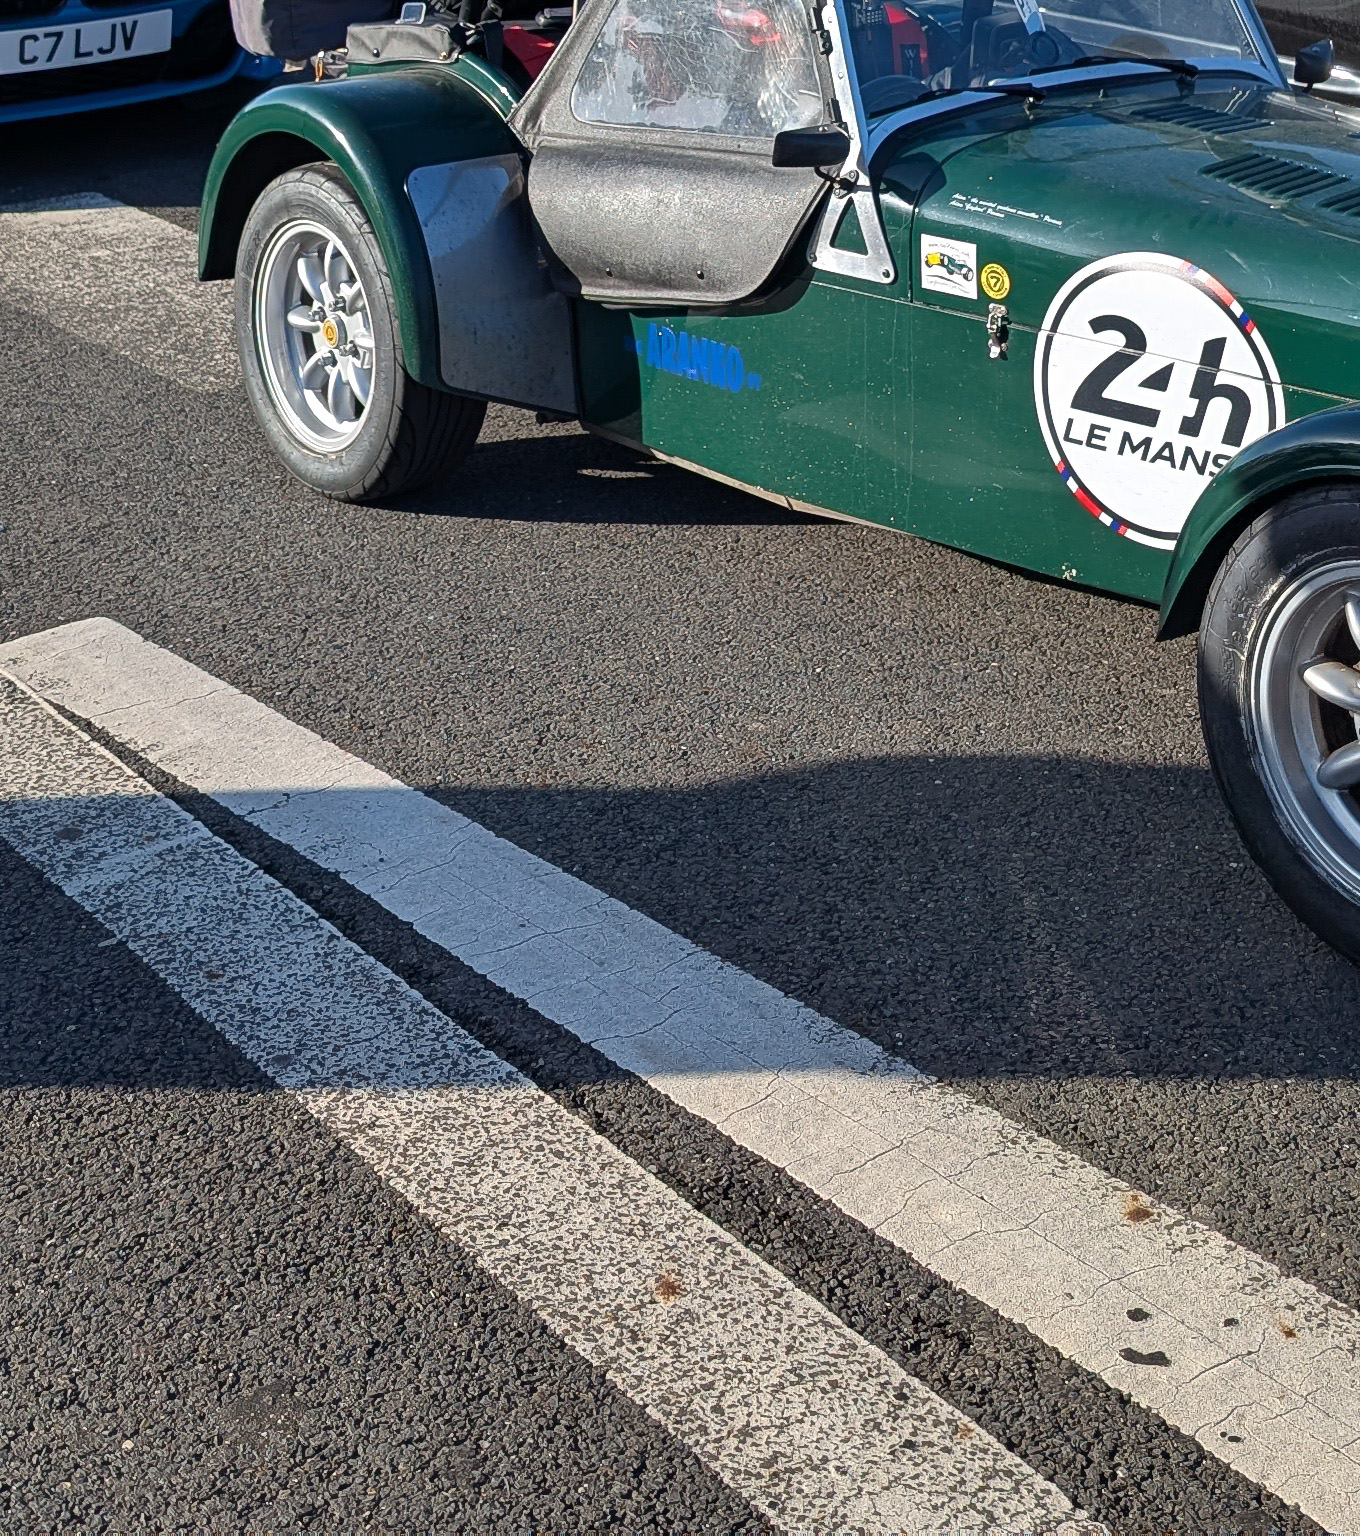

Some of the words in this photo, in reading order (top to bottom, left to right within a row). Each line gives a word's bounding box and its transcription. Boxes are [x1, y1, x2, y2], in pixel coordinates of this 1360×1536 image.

[18, 30, 64, 66] C7
[73, 19, 139, 60] LJV
[1070, 313, 1252, 448] 24h
[1062, 416, 1111, 451] LE
[1117, 430, 1238, 479] MANS
